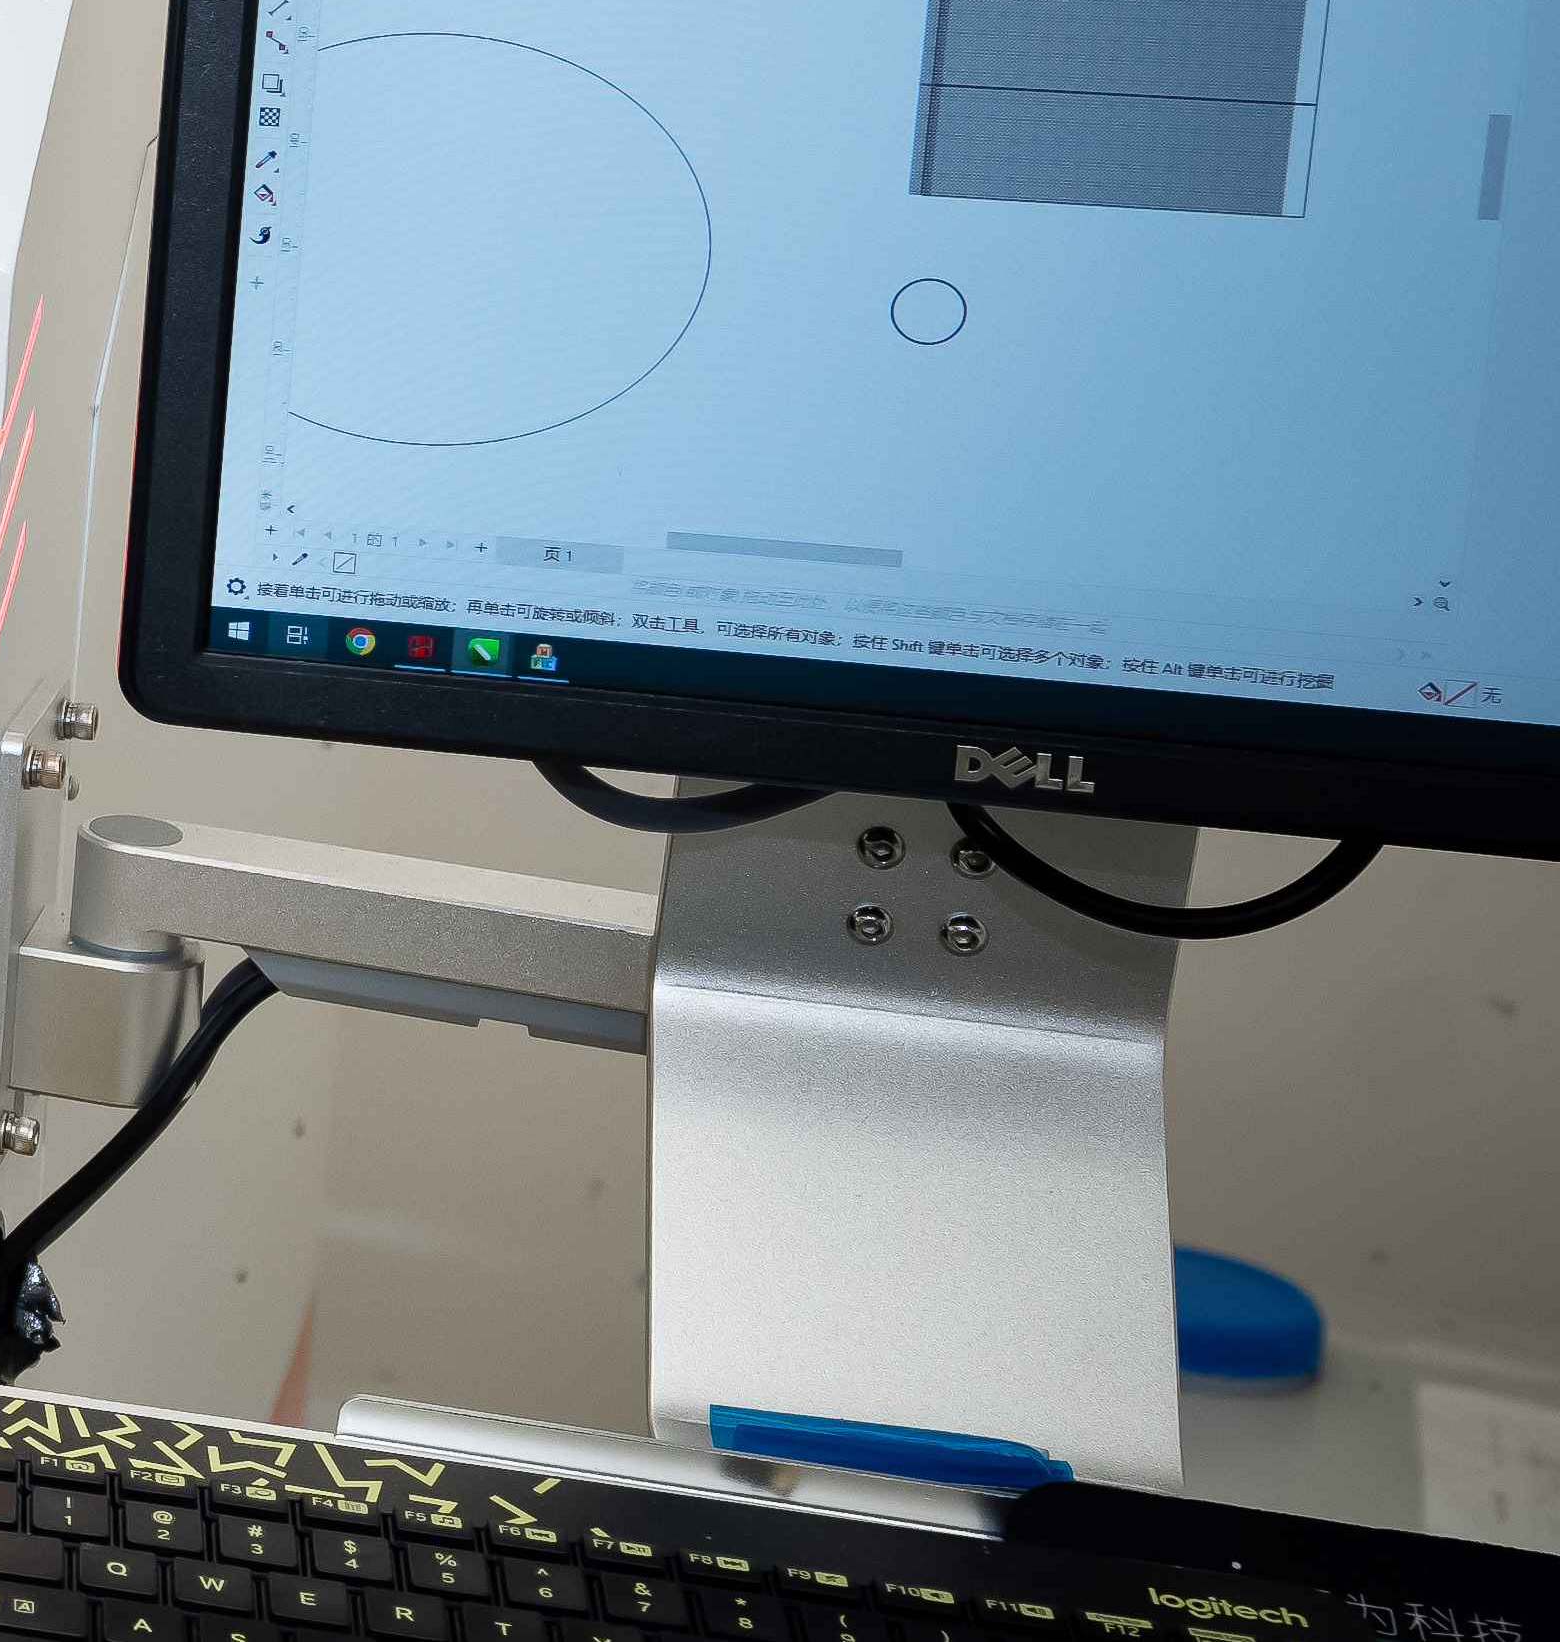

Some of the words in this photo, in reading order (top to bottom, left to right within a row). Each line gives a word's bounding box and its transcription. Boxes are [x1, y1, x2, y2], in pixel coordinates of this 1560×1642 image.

[543, 545, 561, 563] 页
[566, 550, 574, 562] 1
[892, 638, 924, 653] Shift
[1162, 662, 1184, 676] Alt
[1481, 686, 1503, 706] 无
[954, 744, 1095, 794] DELL
[40, 1455, 58, 1468] F1
[130, 1469, 152, 1482] F2
[220, 1482, 242, 1495] F3
[311, 1496, 334, 1508] F4
[64, 1515, 73, 1526] 1
[151, 1510, 173, 1525] @
[404, 1510, 427, 1522] F5
[157, 1529, 171, 1541] 2
[247, 1524, 265, 1538] #
[498, 1524, 521, 1536] F6
[250, 1543, 265, 1556] 3
[343, 1539, 358, 1555] $
[592, 1538, 614, 1550] F7
[344, 1557, 360, 1571] 4
[434, 1551, 458, 1568] %
[688, 1553, 713, 1566] F8
[106, 1561, 128, 1577] Q
[786, 1567, 811, 1580] F9
[199, 1575, 225, 1592] W
[440, 1572, 456, 1585] 5
[538, 1587, 554, 1599] 6
[633, 1582, 653, 1597] &
[884, 1582, 921, 1598] F10
[298, 1591, 318, 1607] E
[985, 1598, 1020, 1613] F11
[636, 1600, 652, 1613] 7
[1147, 1586, 1310, 1629] logitech
[394, 1606, 415, 1623] R
[132, 1617, 153, 1633] A
[494, 1620, 513, 1637] T
[738, 1616, 754, 1630] 8
[1104, 1622, 1141, 1638] F12
